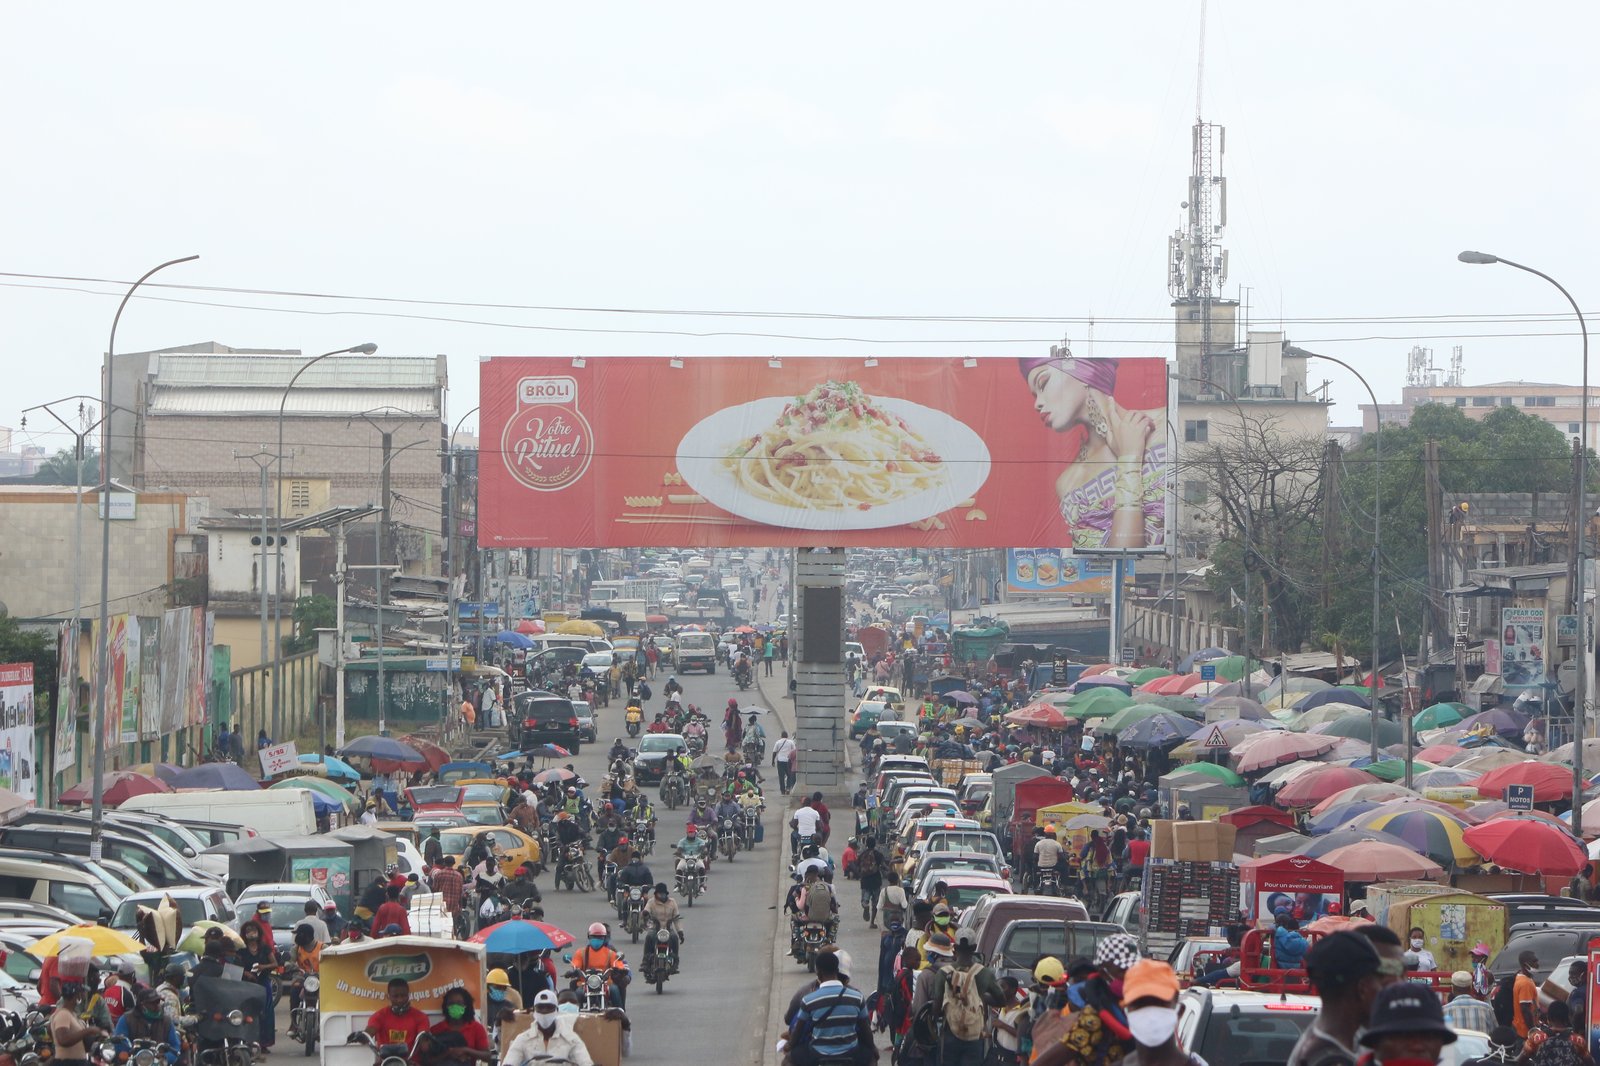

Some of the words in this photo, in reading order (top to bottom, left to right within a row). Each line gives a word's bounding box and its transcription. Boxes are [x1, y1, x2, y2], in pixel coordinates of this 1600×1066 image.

[526, 385, 569, 396] BROLI
[526, 416, 572, 439] Votre
[514, 435, 581, 470] Rituel
[296, 768, 319, 776] MoMo
[1518, 787, 1524, 795] P
[373, 961, 427, 978] Tiara
[336, 979, 349, 992] Un
[351, 985, 386, 1000] sourire
